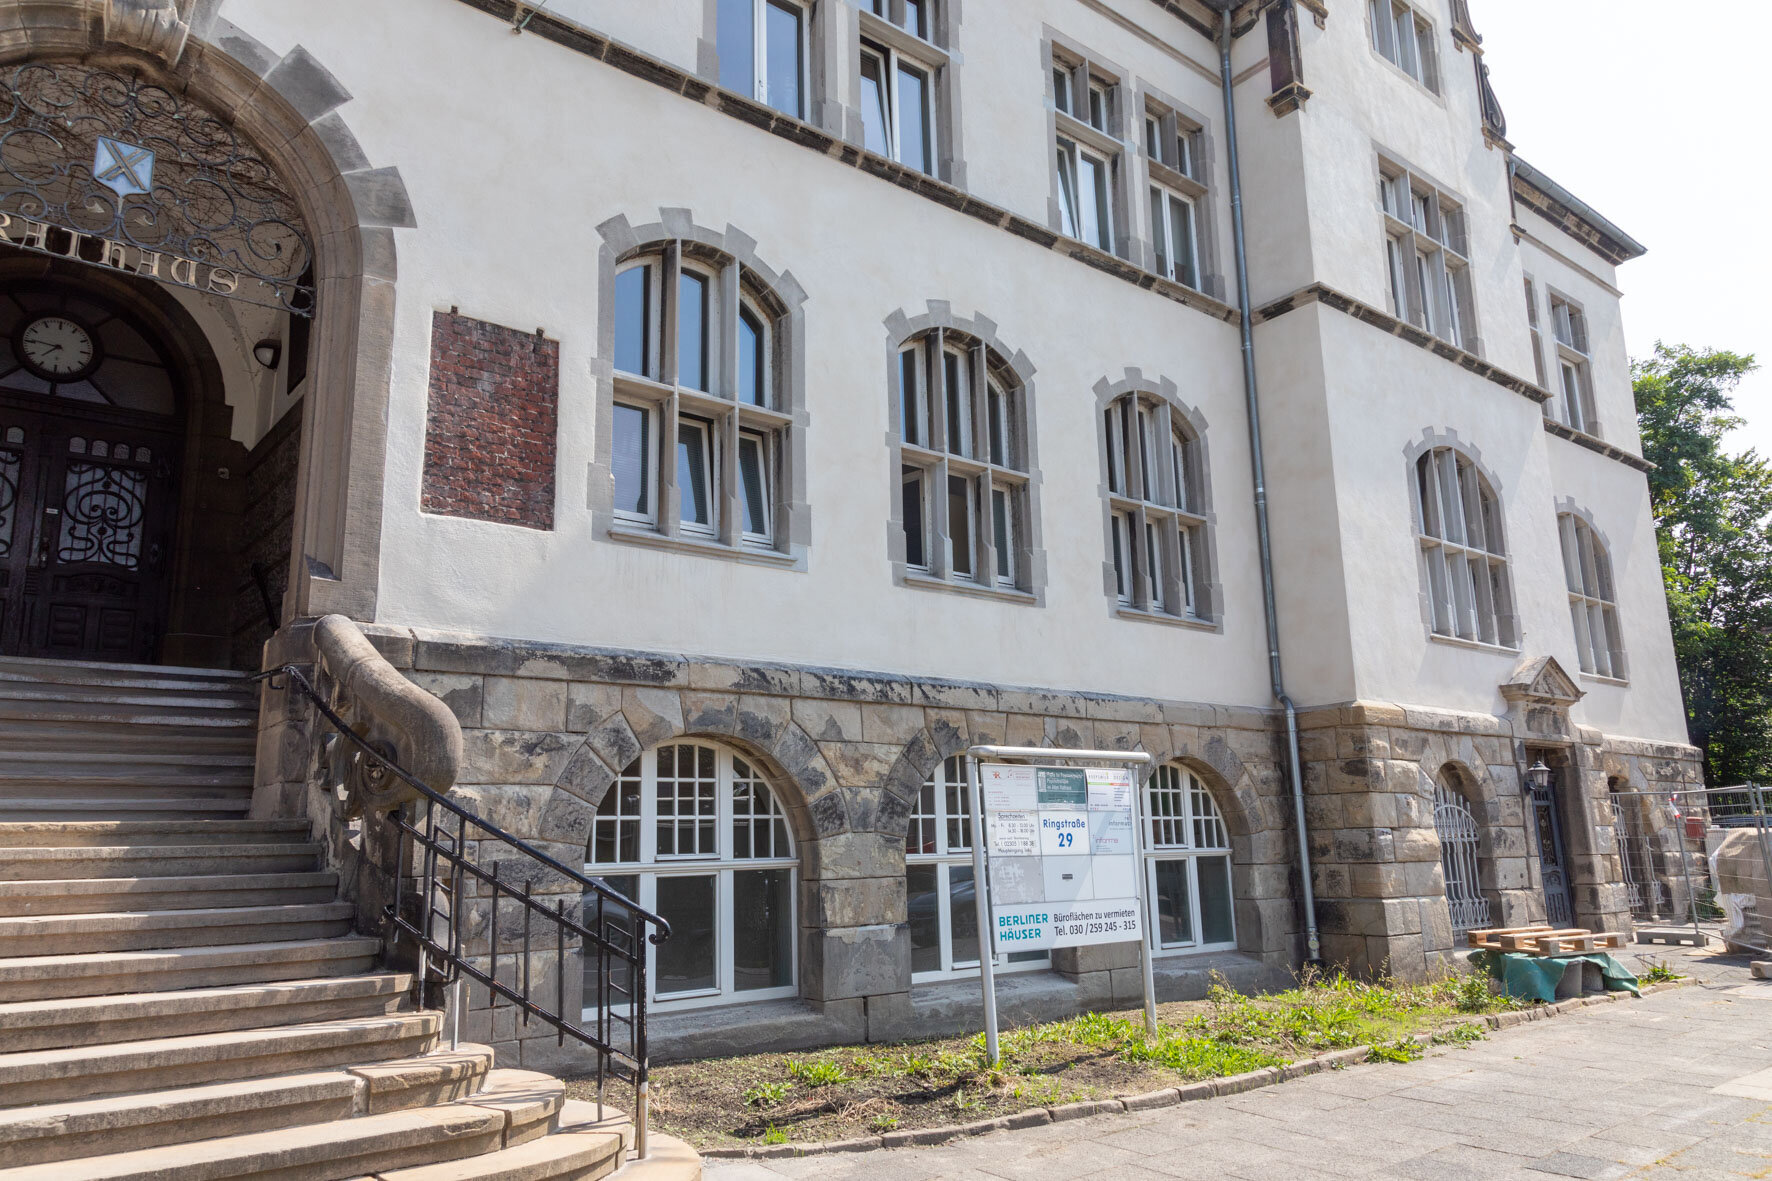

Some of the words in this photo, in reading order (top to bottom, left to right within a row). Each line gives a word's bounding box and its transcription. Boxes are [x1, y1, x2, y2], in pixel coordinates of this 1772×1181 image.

[1043, 818, 1085, 830] Ringstraße
[1058, 832, 1073, 848] 29
[999, 913, 1049, 927] BERLINER
[1053, 911, 1094, 923] Büroflächen
[1094, 912, 1103, 920] zu
[1104, 909, 1135, 918] vermieten
[1000, 928, 1041, 941] HÄUSER
[1054, 925, 1068, 936] Tel.
[1069, 924, 1084, 935] 030
[1104, 921, 1118, 932] 245
[1123, 920, 1136, 931] 315
